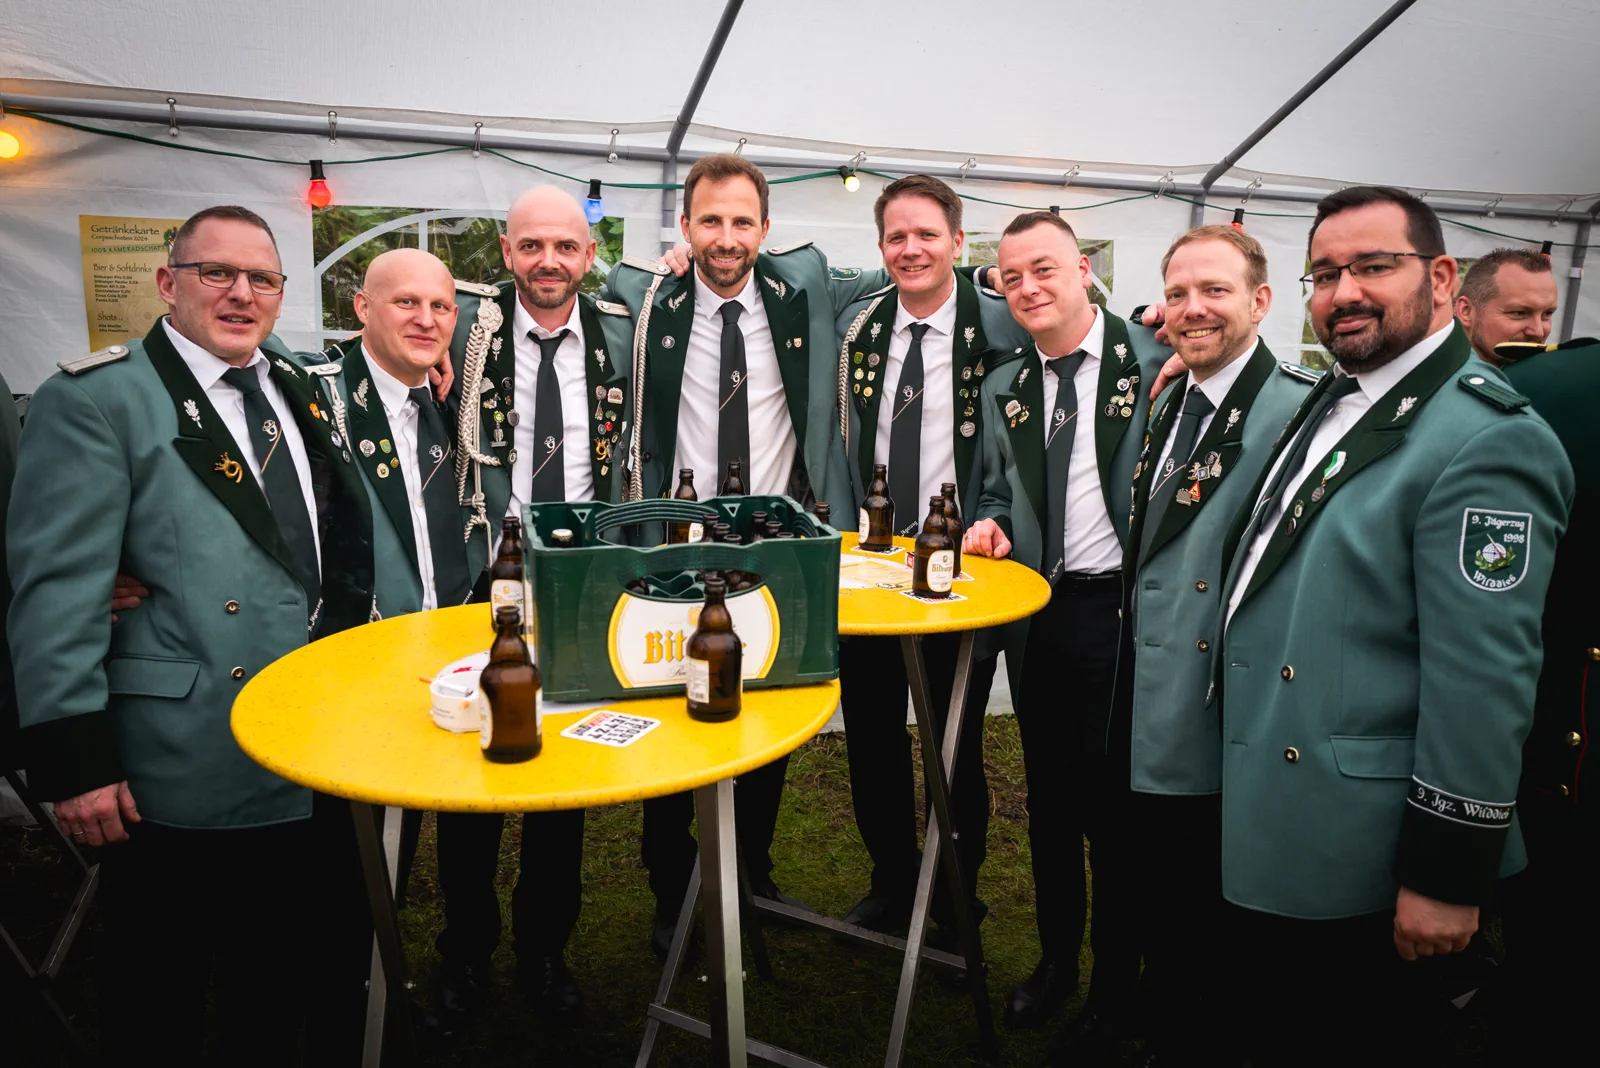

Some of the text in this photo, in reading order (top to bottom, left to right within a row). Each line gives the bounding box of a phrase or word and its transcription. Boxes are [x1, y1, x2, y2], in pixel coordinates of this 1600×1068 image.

[91, 224, 160, 235] Getränkekarte
[93, 263, 107, 271] Bier
[116, 262, 152, 272] Softdrinks
[97, 311, 117, 321] Shots
[1472, 515, 1481, 524] 9.
[1504, 533, 1525, 543] 1998
[1417, 787, 1427, 802] 9.
[1431, 792, 1456, 812] Jgz.
